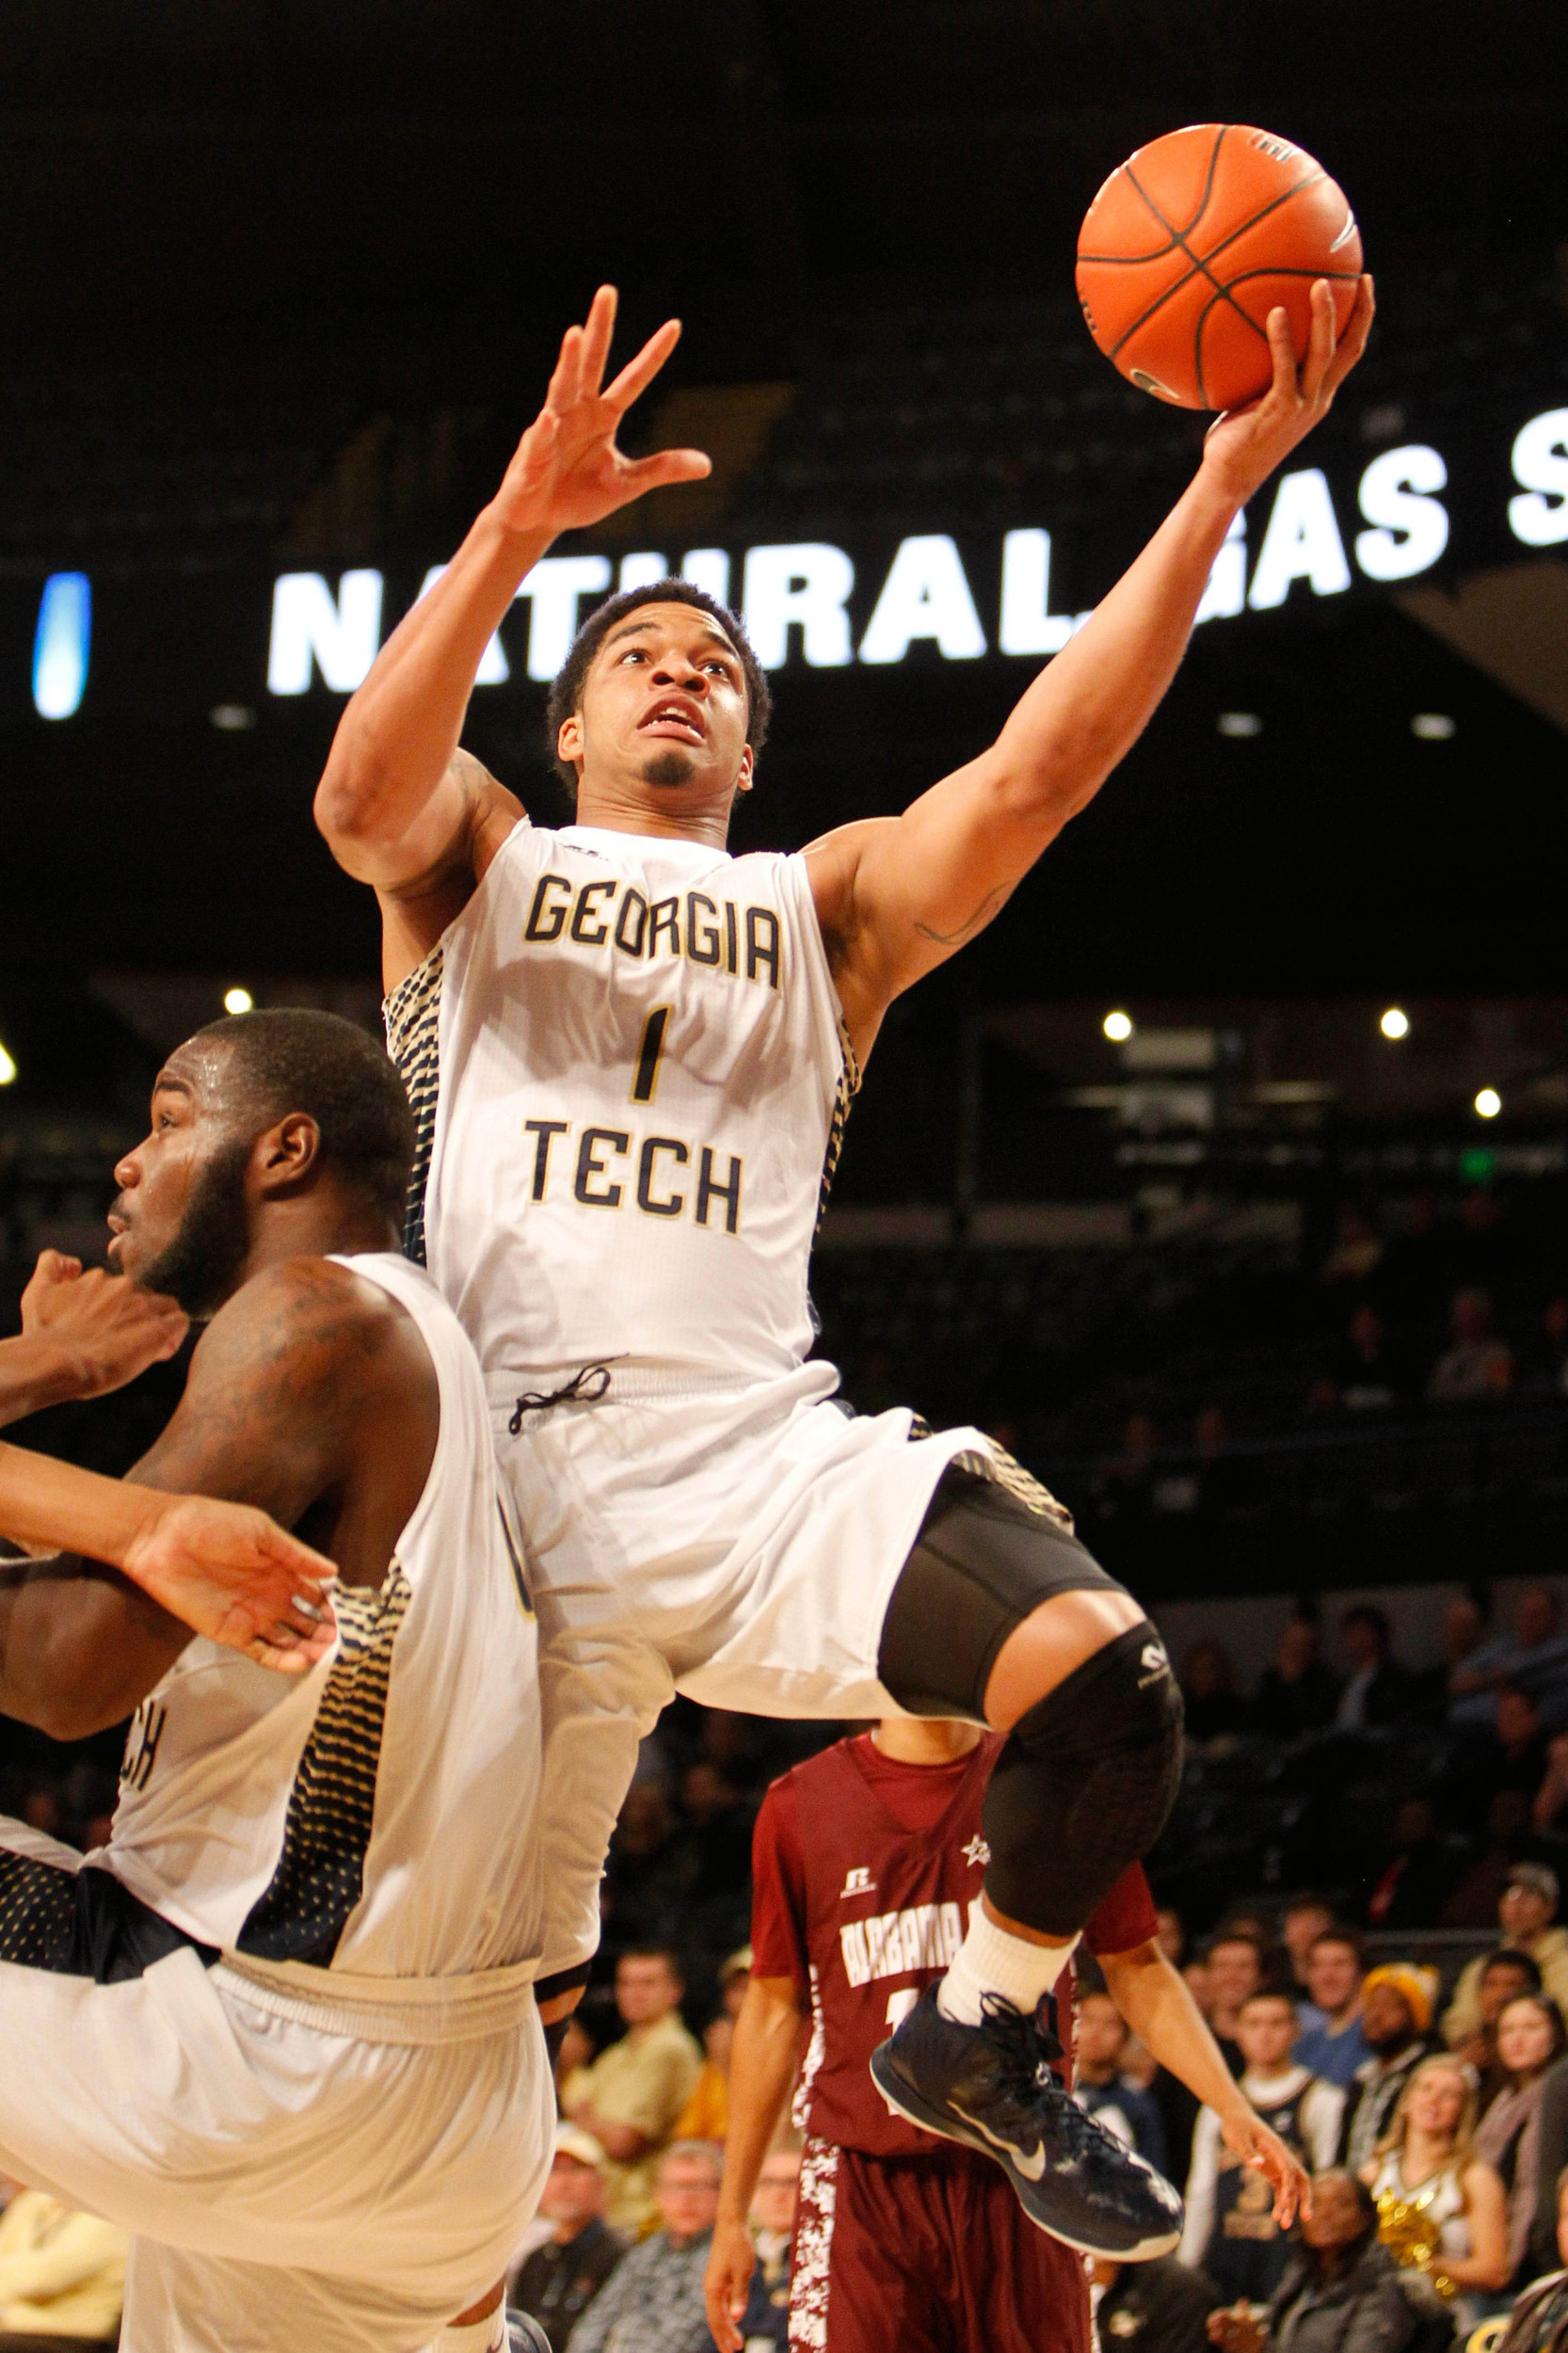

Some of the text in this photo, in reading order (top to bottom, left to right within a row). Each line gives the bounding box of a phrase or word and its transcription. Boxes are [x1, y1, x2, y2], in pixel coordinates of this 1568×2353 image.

[267, 528, 1095, 696] NTRAL
[523, 873, 781, 990] GEORGIA
[630, 1003, 669, 1104] 1
[523, 1118, 744, 1236] TECH
